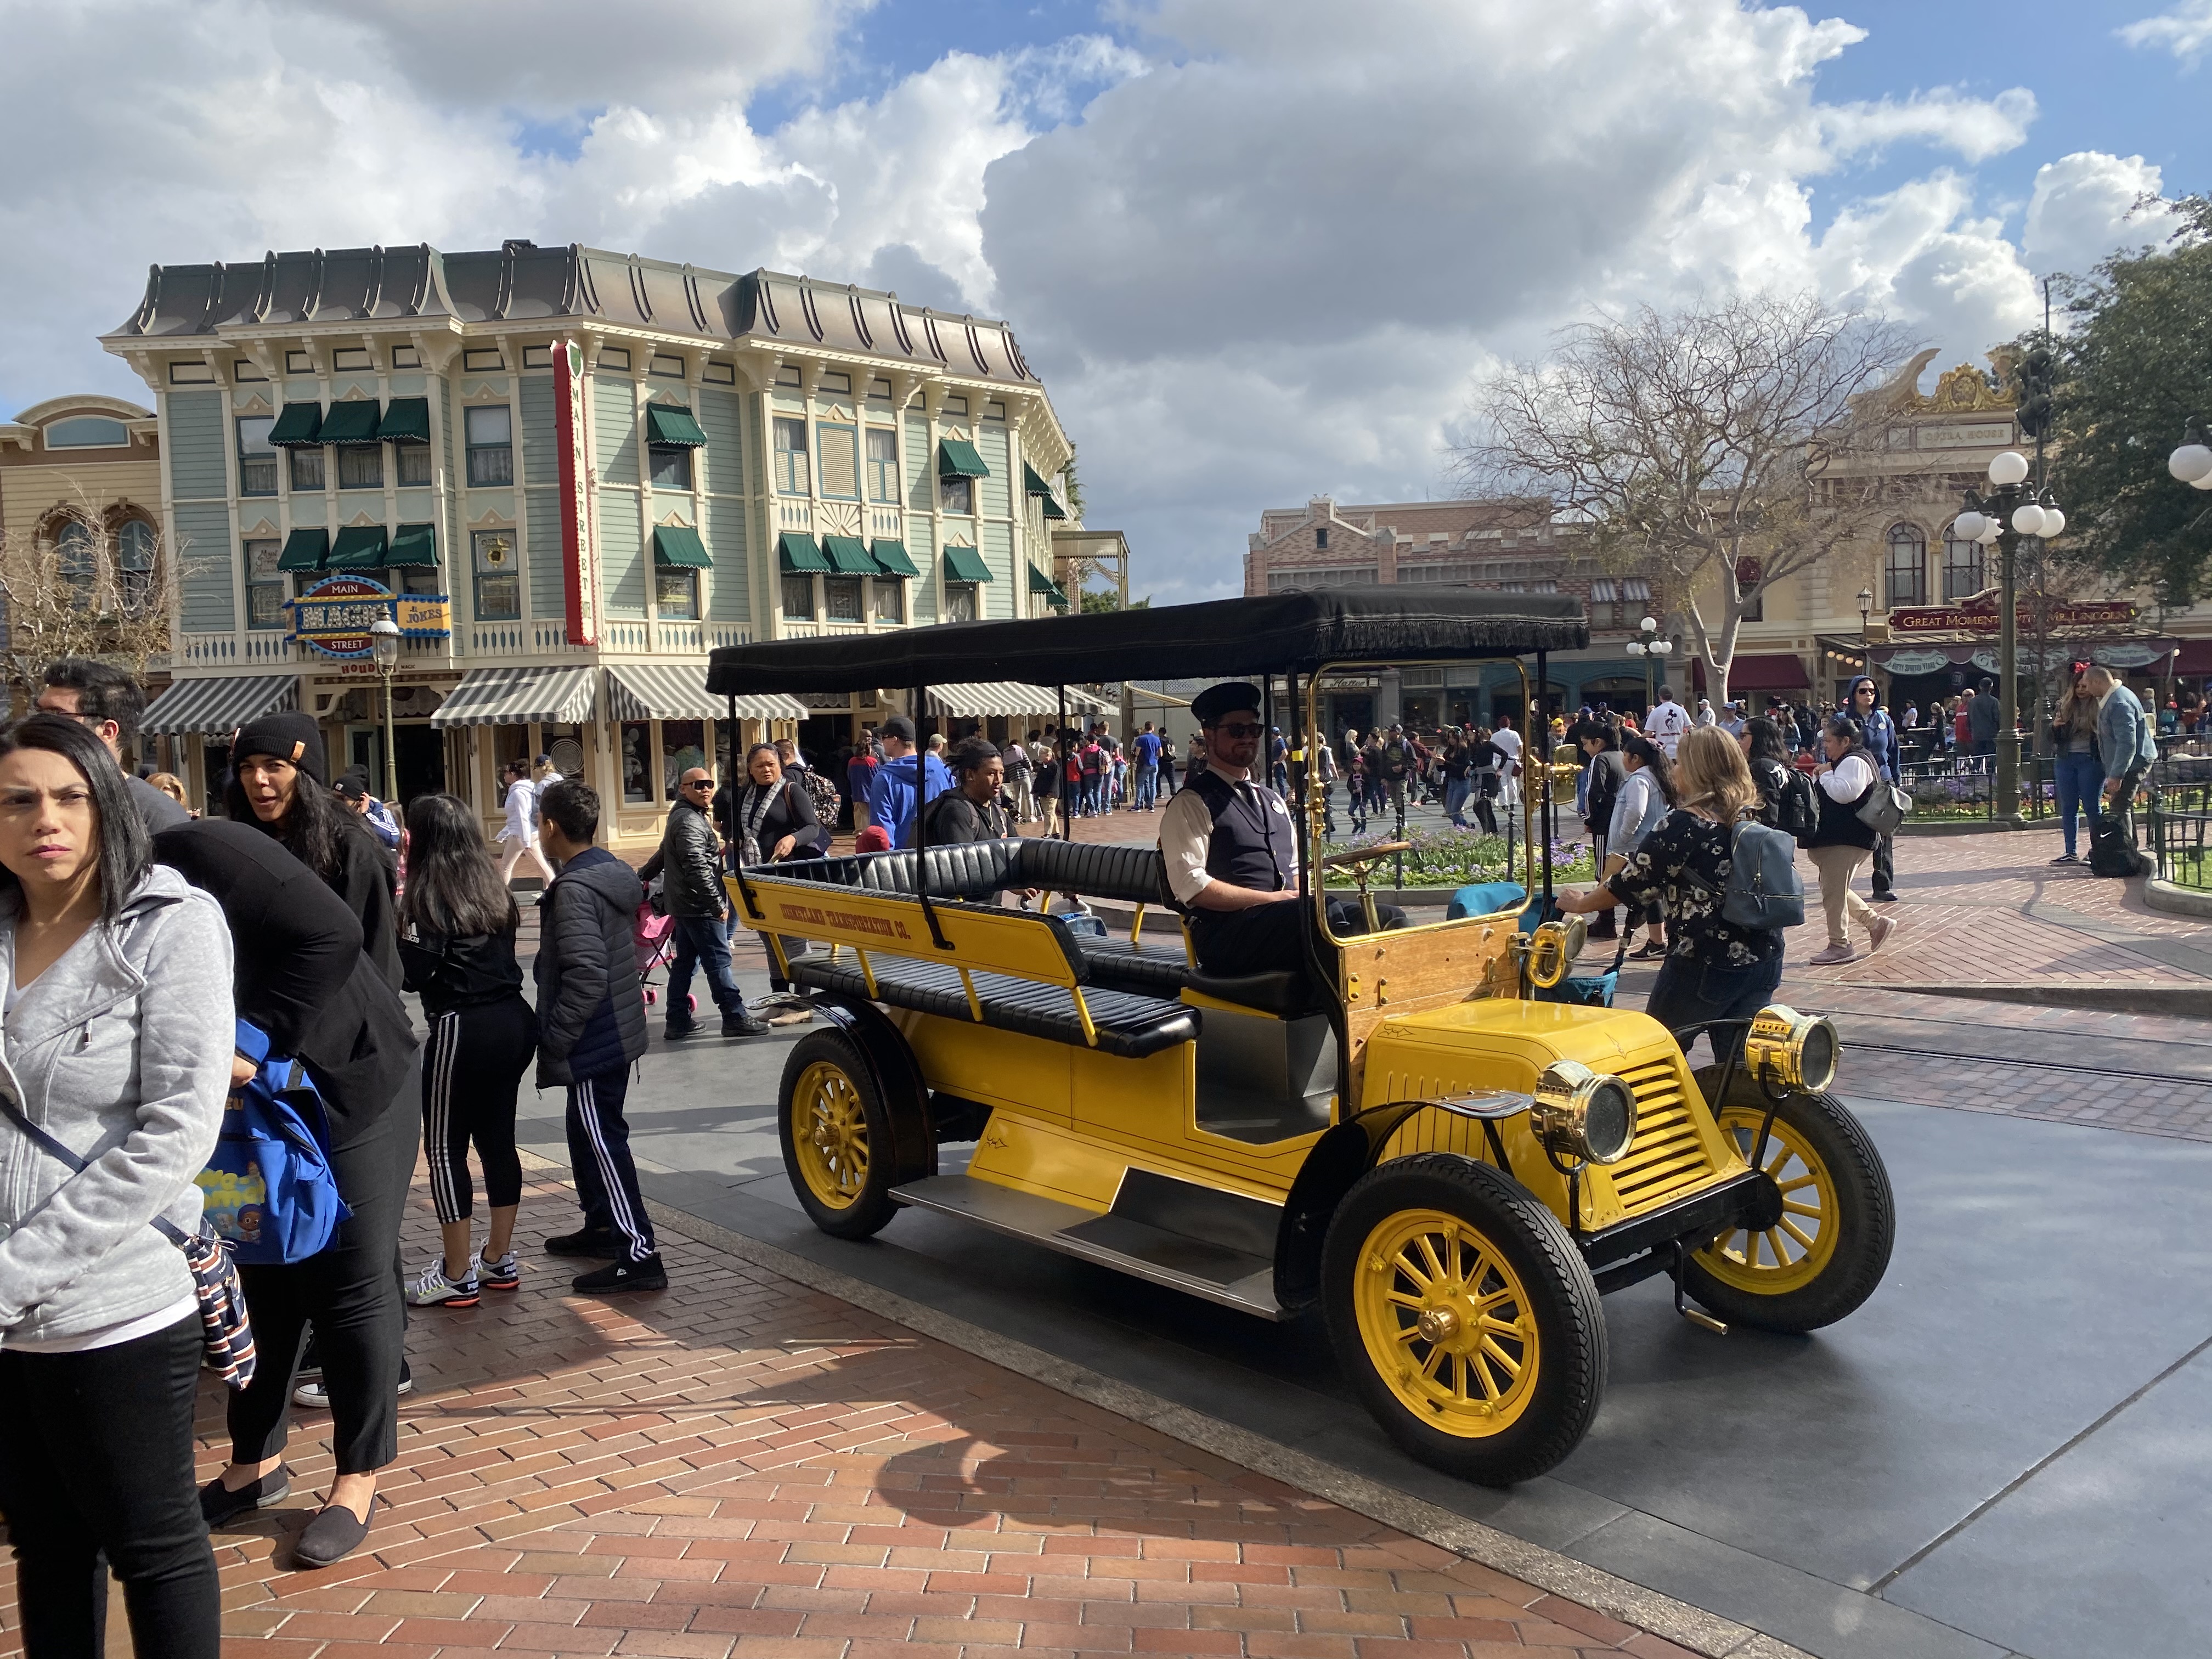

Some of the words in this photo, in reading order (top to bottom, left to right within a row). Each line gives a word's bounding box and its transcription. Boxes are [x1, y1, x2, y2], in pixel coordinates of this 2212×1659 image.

[1925, 431, 1962, 441] OPERA
[1967, 430, 2005, 439] HOUSE
[572, 387, 582, 460] MAIN
[577, 481, 588, 590] STREET
[331, 584, 358, 594] MAIN
[407, 608, 442, 623] JOKES
[1903, 616, 1942, 627] GREAT
[1946, 615, 2000, 626] MOMENT
[331, 640, 364, 649] STREET
[779, 903, 826, 926] DISNEYLAND
[825, 910, 895, 937] TRANSPORTATION
[894, 920, 911, 940] CO.
